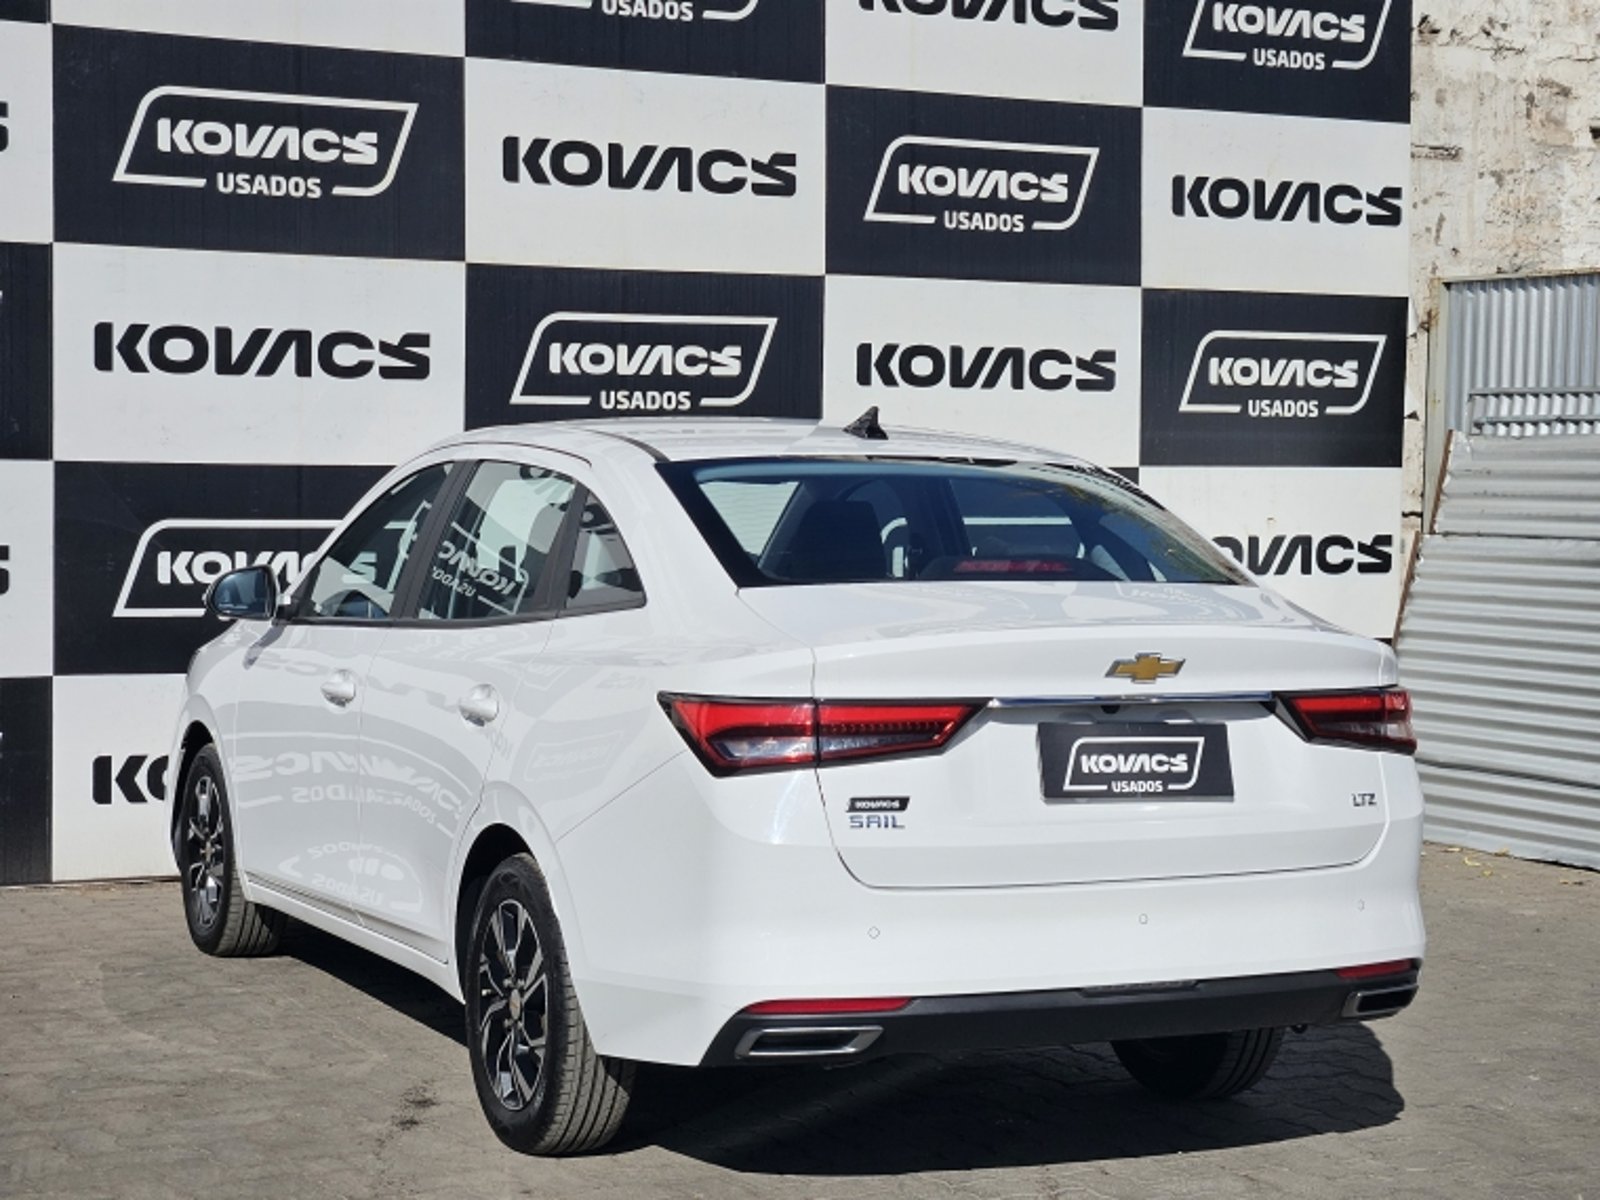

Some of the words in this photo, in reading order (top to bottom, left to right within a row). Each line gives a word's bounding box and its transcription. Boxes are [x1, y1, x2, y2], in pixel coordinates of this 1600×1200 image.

[602, 0, 693, 21] USADOS
[1213, 2, 1365, 42] KOVACS
[1253, 48, 1325, 70] USADOS
[157, 118, 378, 165] KOVACS
[503, 136, 796, 196] KOVACS
[216, 172, 322, 198] USADOS
[898, 164, 1068, 202] KOVACS
[1172, 175, 1402, 226] KOVACS
[944, 210, 1024, 232] USADOS
[94, 322, 430, 380] KOVACS
[548, 342, 742, 376] KOVACS
[857, 343, 1116, 391] KOVACS
[1208, 358, 1358, 388] KOVACS
[600, 390, 691, 410] USADOS
[1248, 399, 1319, 417] USADOS
[1211, 534, 1393, 575] VACS
[1080, 753, 1189, 774] KOVACS
[1111, 780, 1164, 793] USADOS
[1351, 792, 1377, 807] LTZ
[855, 799, 900, 809] KOVACS
[849, 814, 905, 829] SAIL
